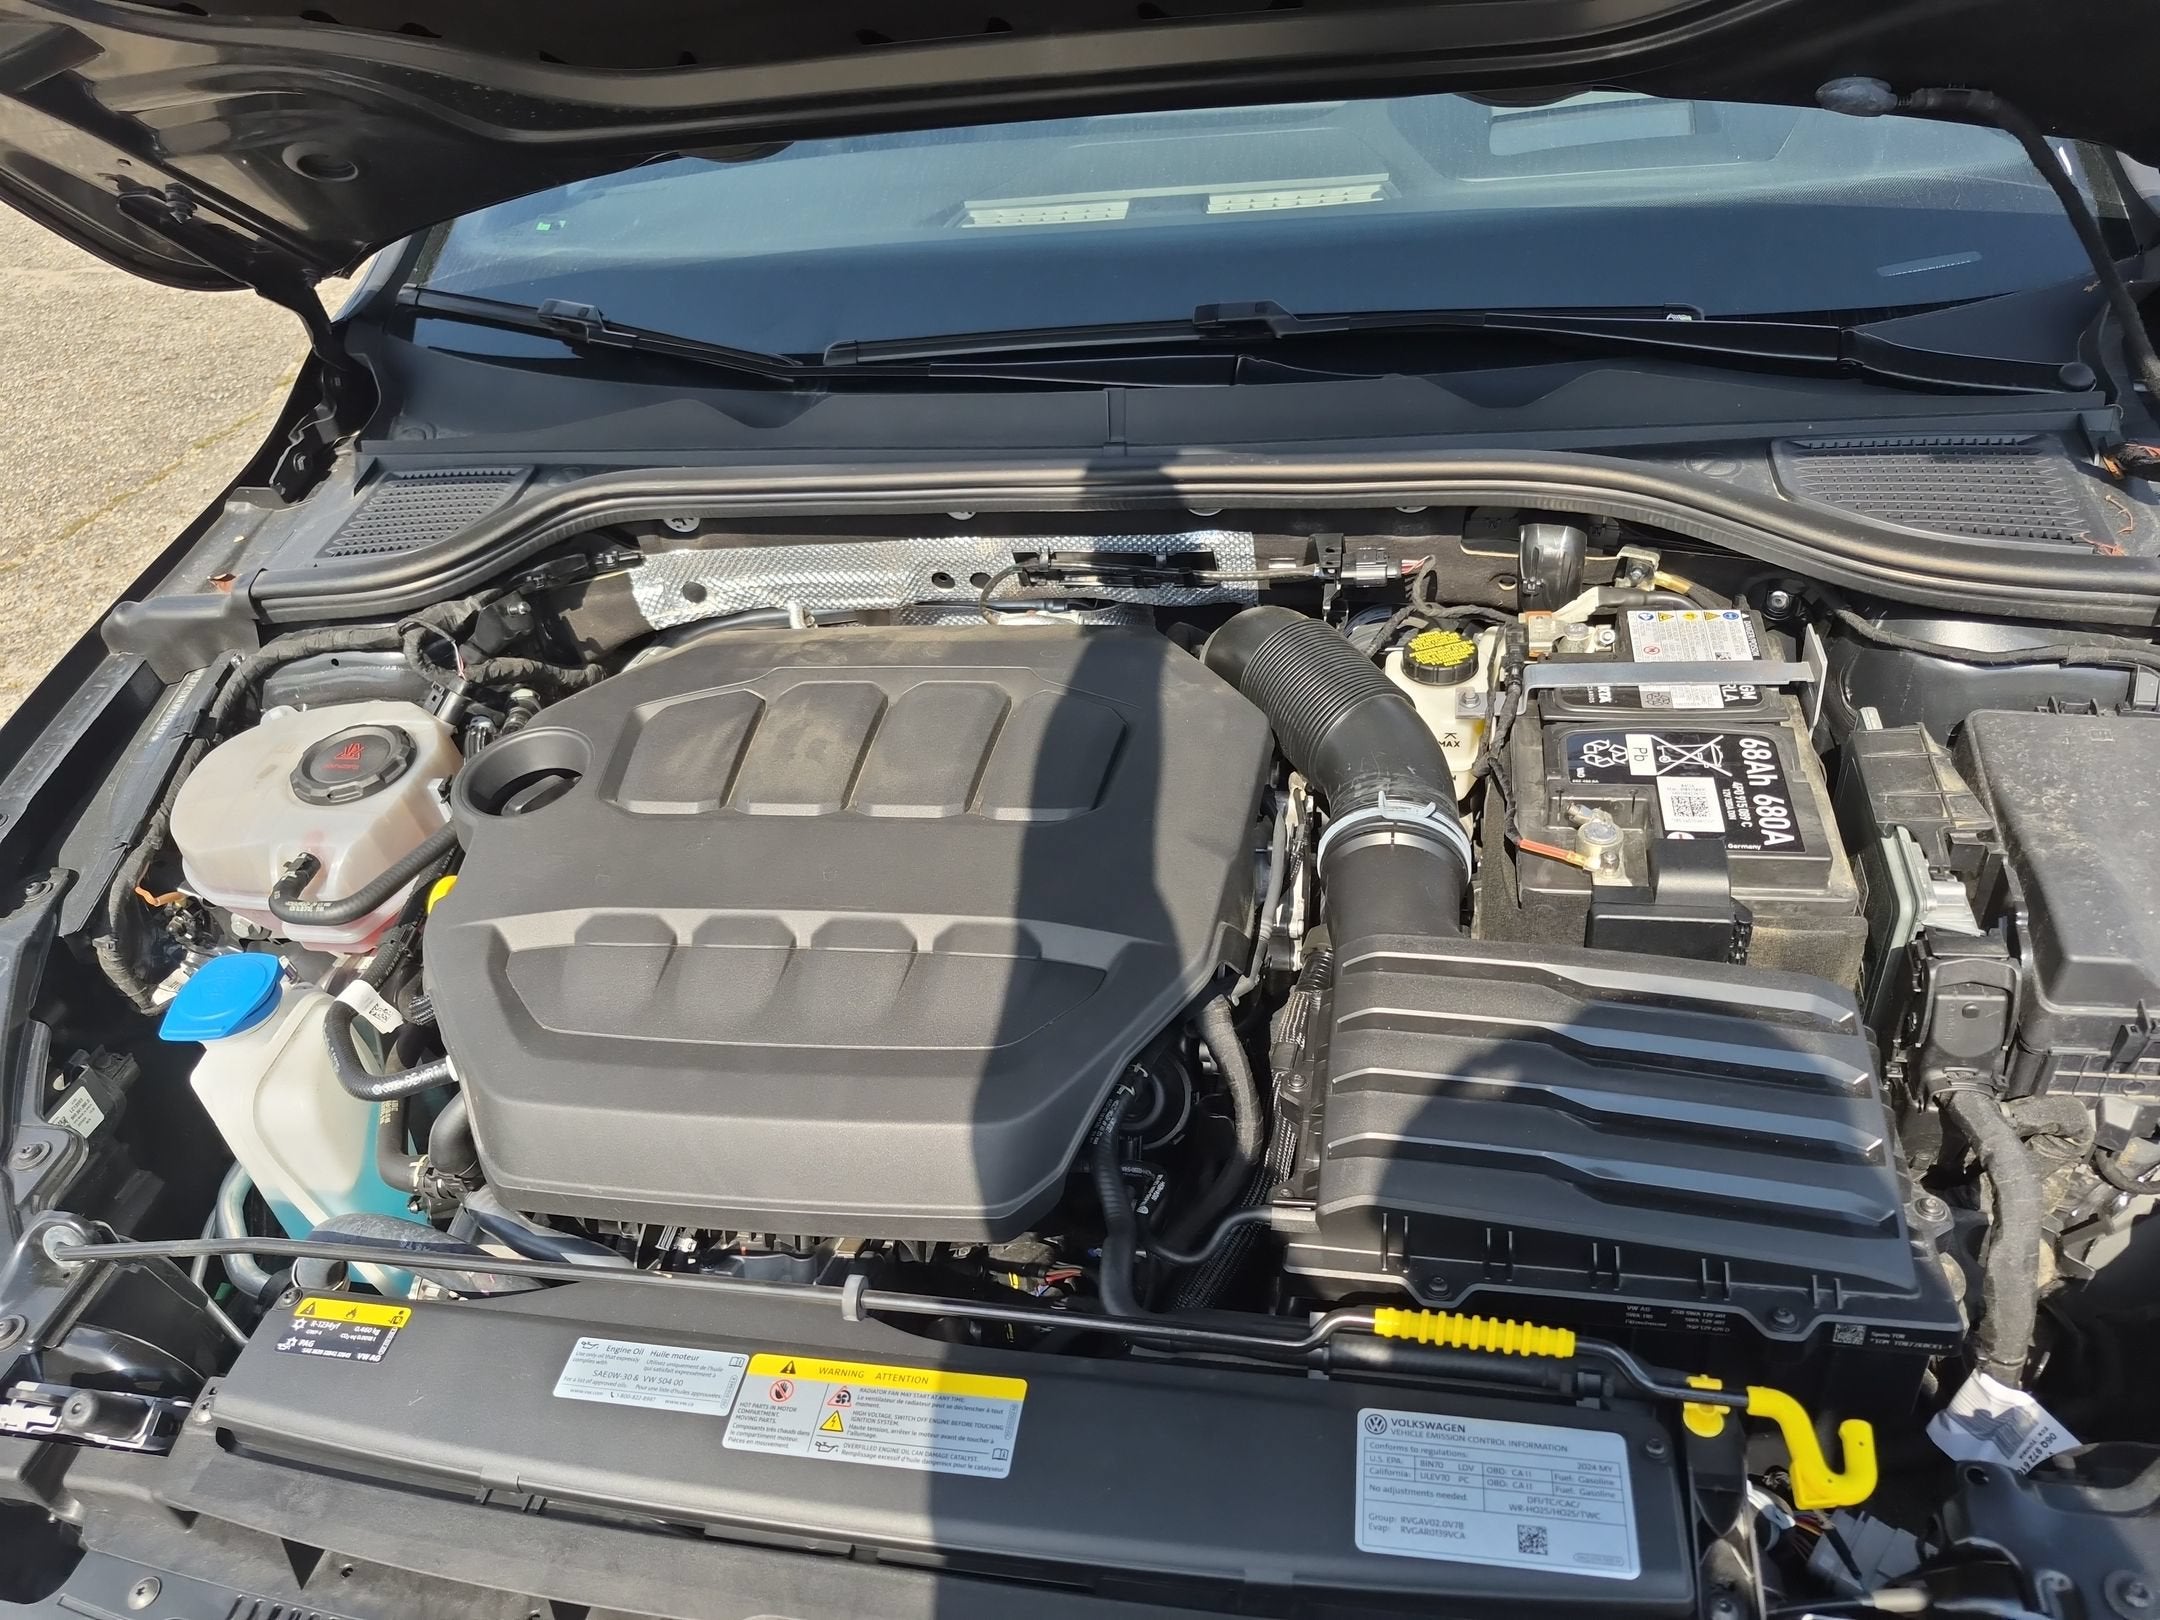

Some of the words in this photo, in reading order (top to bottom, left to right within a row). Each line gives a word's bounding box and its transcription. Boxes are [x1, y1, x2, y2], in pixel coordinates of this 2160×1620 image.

[1632, 748, 1648, 761] Pb
[1739, 738, 1778, 785] 68Ah
[1753, 794, 1794, 845] 680A
[606, 1345, 631, 1354] Engine
[819, 1367, 864, 1378] WARNING
[875, 1372, 929, 1384] ATTENTION
[954, 1404, 985, 1412] déclencher
[733, 1423, 765, 1431] Composants
[951, 1419, 973, 1427] BEFORE
[974, 1422, 1004, 1430] TOUCHING
[1391, 1418, 1466, 1433] VOLKSWAGEN
[736, 1431, 776, 1439] compartiment
[1391, 1429, 1423, 1438] VEHICLE
[1426, 1432, 1466, 1442] EMISSION
[1468, 1436, 1506, 1446] CONTROL
[1509, 1440, 1568, 1452] INFORMATION
[843, 1442, 877, 1451] OVERFILLED
[1369, 1442, 1408, 1453] Conforms
[841, 1450, 876, 1459] Remplissage
[922, 1459, 951, 1467] dangereux
[1420, 1460, 1444, 1469] BIN70
[1577, 1462, 1596, 1471] 2024
[1420, 1472, 1450, 1482] ULEV70
[1578, 1475, 1615, 1486] Gasoline
[1382, 1486, 1434, 1498] adjustments
[1579, 1488, 1616, 1498] Gasoline
